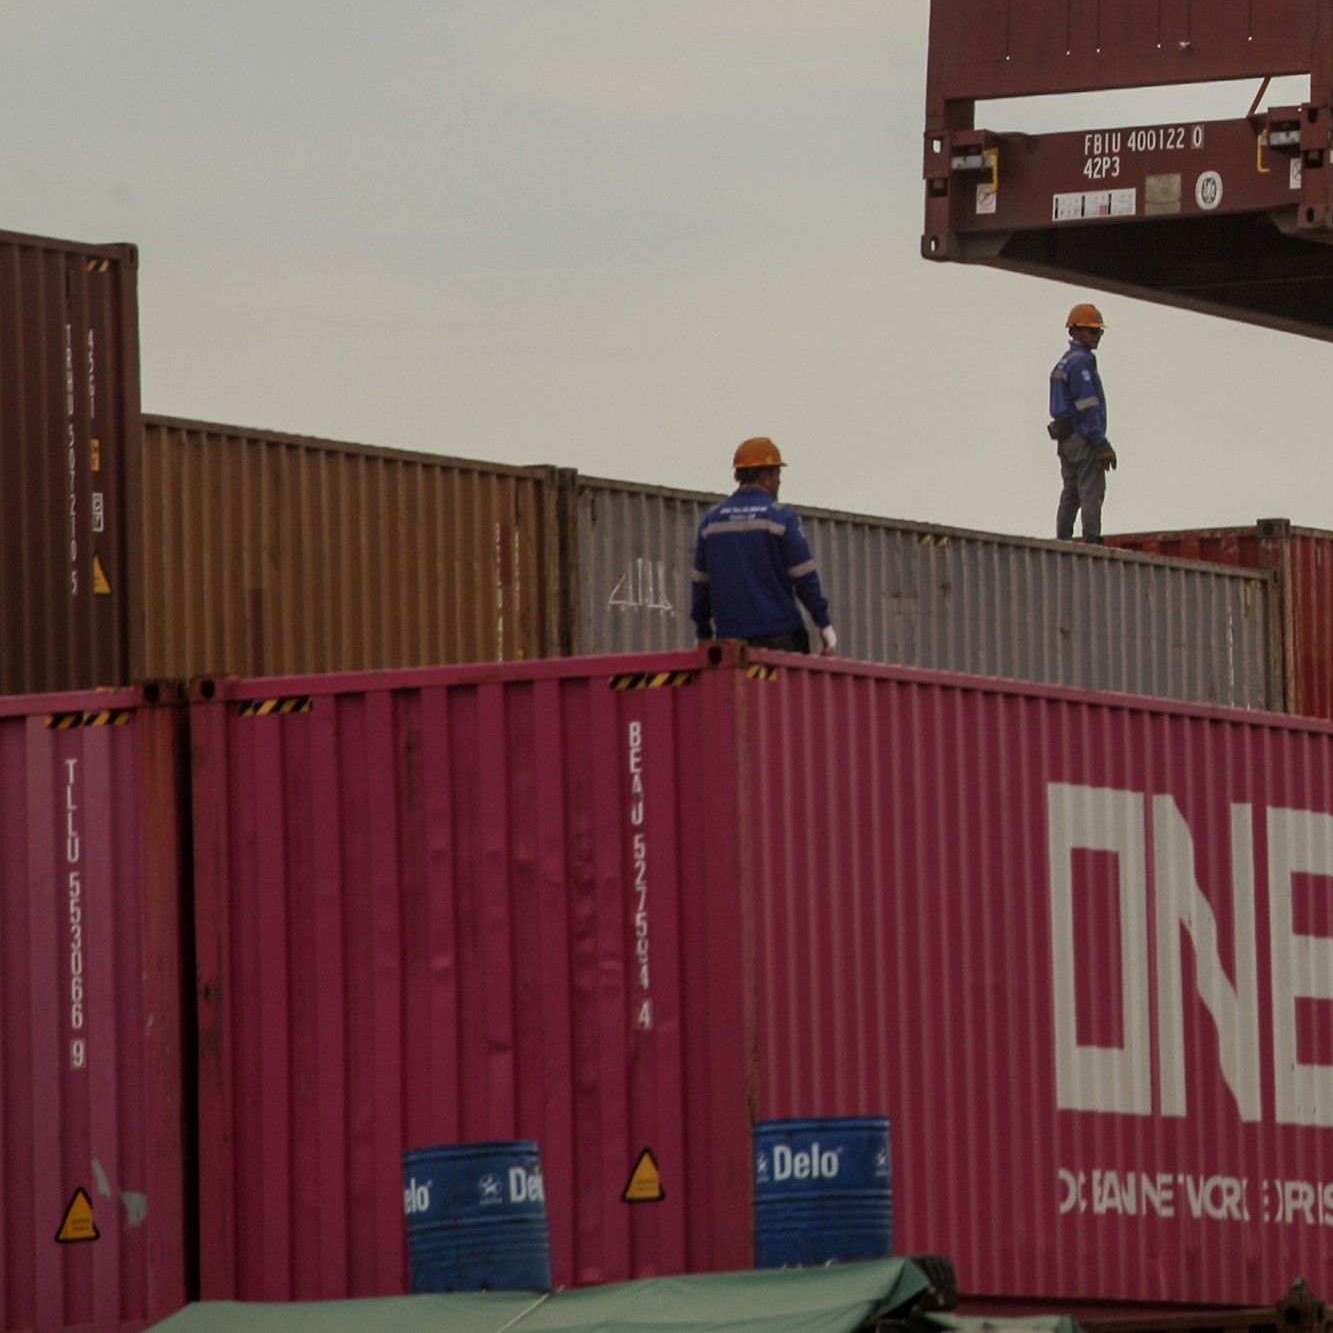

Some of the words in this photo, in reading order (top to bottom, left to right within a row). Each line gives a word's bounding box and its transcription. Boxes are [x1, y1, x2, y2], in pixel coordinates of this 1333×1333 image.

[1084, 132, 1122, 156] FBIU
[1127, 127, 1185, 152] 400122
[1192, 125, 1203, 148] 0
[1083, 156, 1121, 179] 42P3
[629, 721, 645, 826] BEAU
[65, 758, 80, 863] TLLU
[69, 872, 83, 1030] 553066
[71, 1039, 85, 1069] 9
[773, 1142, 839, 1182] Delo
[1058, 1167, 1138, 1216] OEAN
